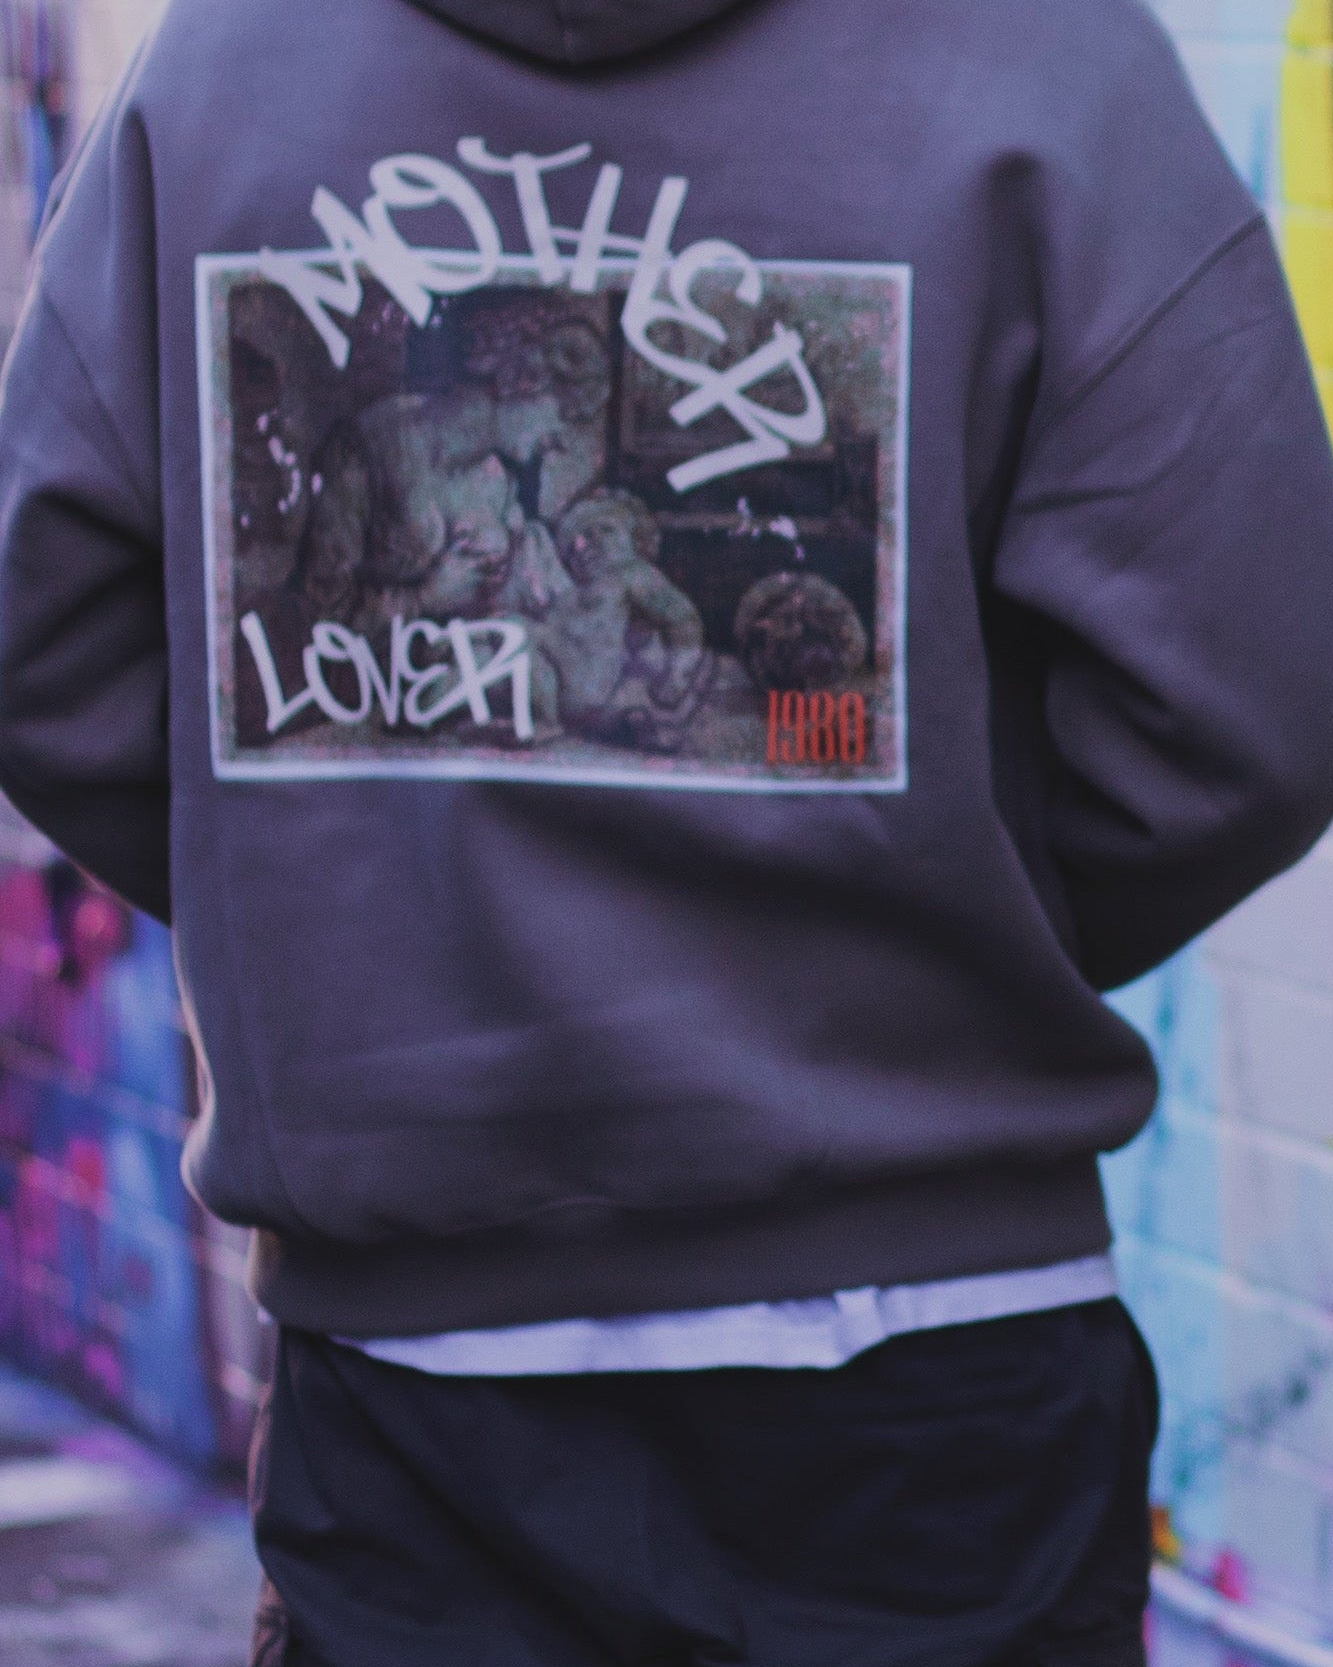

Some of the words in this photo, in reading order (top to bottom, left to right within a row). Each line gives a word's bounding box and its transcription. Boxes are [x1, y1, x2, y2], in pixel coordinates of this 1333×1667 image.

[259, 137, 827, 493] MOTHER
[241, 609, 536, 740] LOVER
[767, 689, 866, 766] 1980
